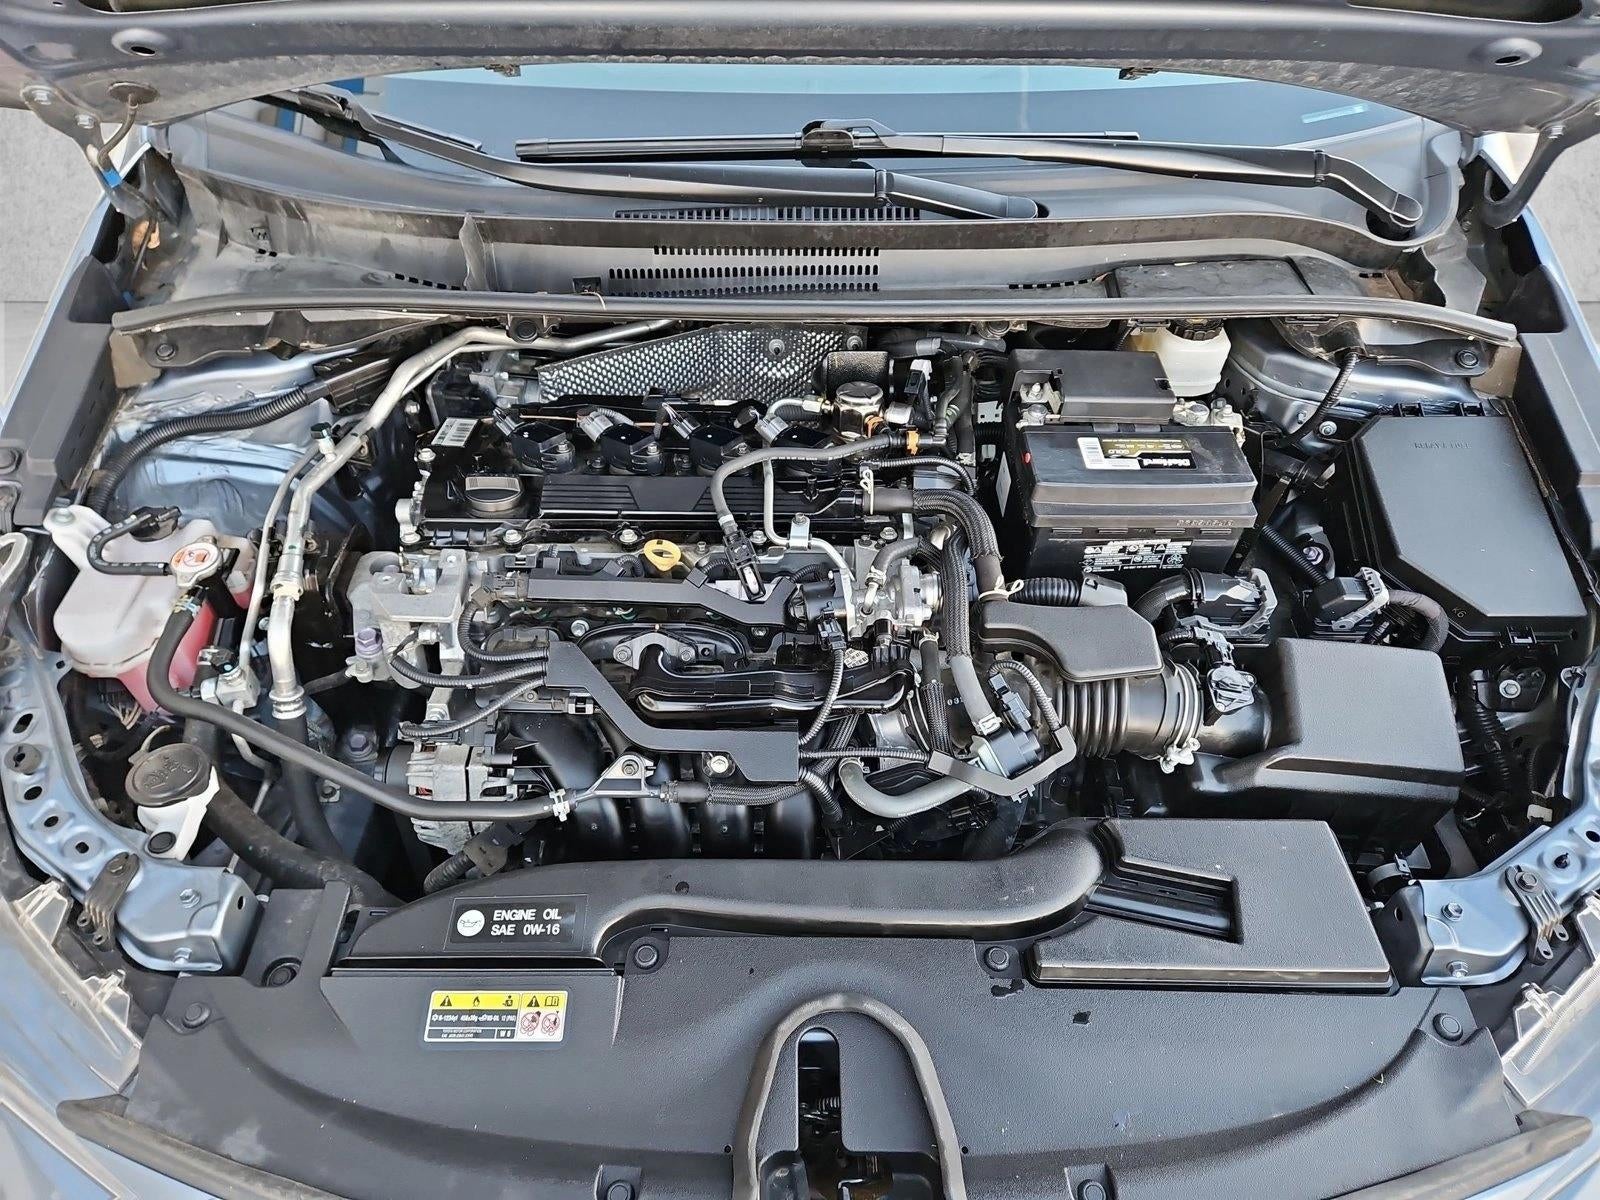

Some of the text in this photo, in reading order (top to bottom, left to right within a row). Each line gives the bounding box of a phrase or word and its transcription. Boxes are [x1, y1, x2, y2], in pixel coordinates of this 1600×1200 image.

[493, 908, 562, 921] ENGINE OIL
[490, 923, 560, 936] SAE 0W-16
